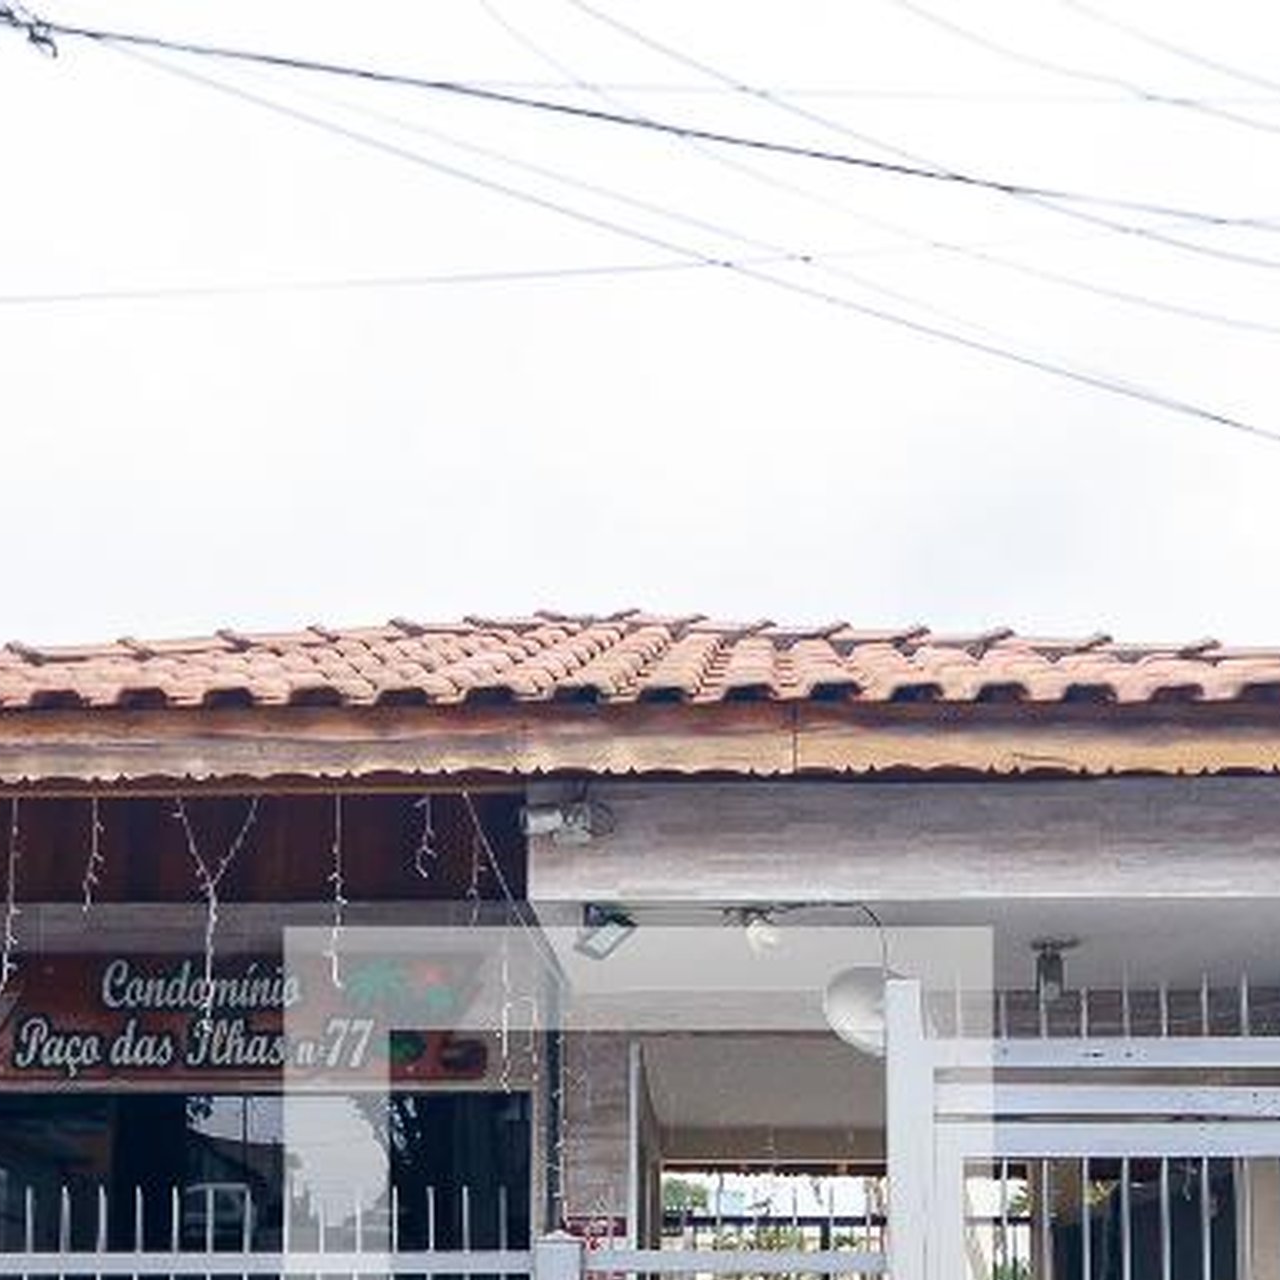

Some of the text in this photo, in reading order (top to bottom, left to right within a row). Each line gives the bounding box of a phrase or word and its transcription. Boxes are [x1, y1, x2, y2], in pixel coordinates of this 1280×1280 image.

[103, 959, 300, 1008] Condomínio
[16, 1018, 101, 1077] Paço
[112, 1019, 173, 1067] das
[188, 1018, 286, 1067] Ilhas
